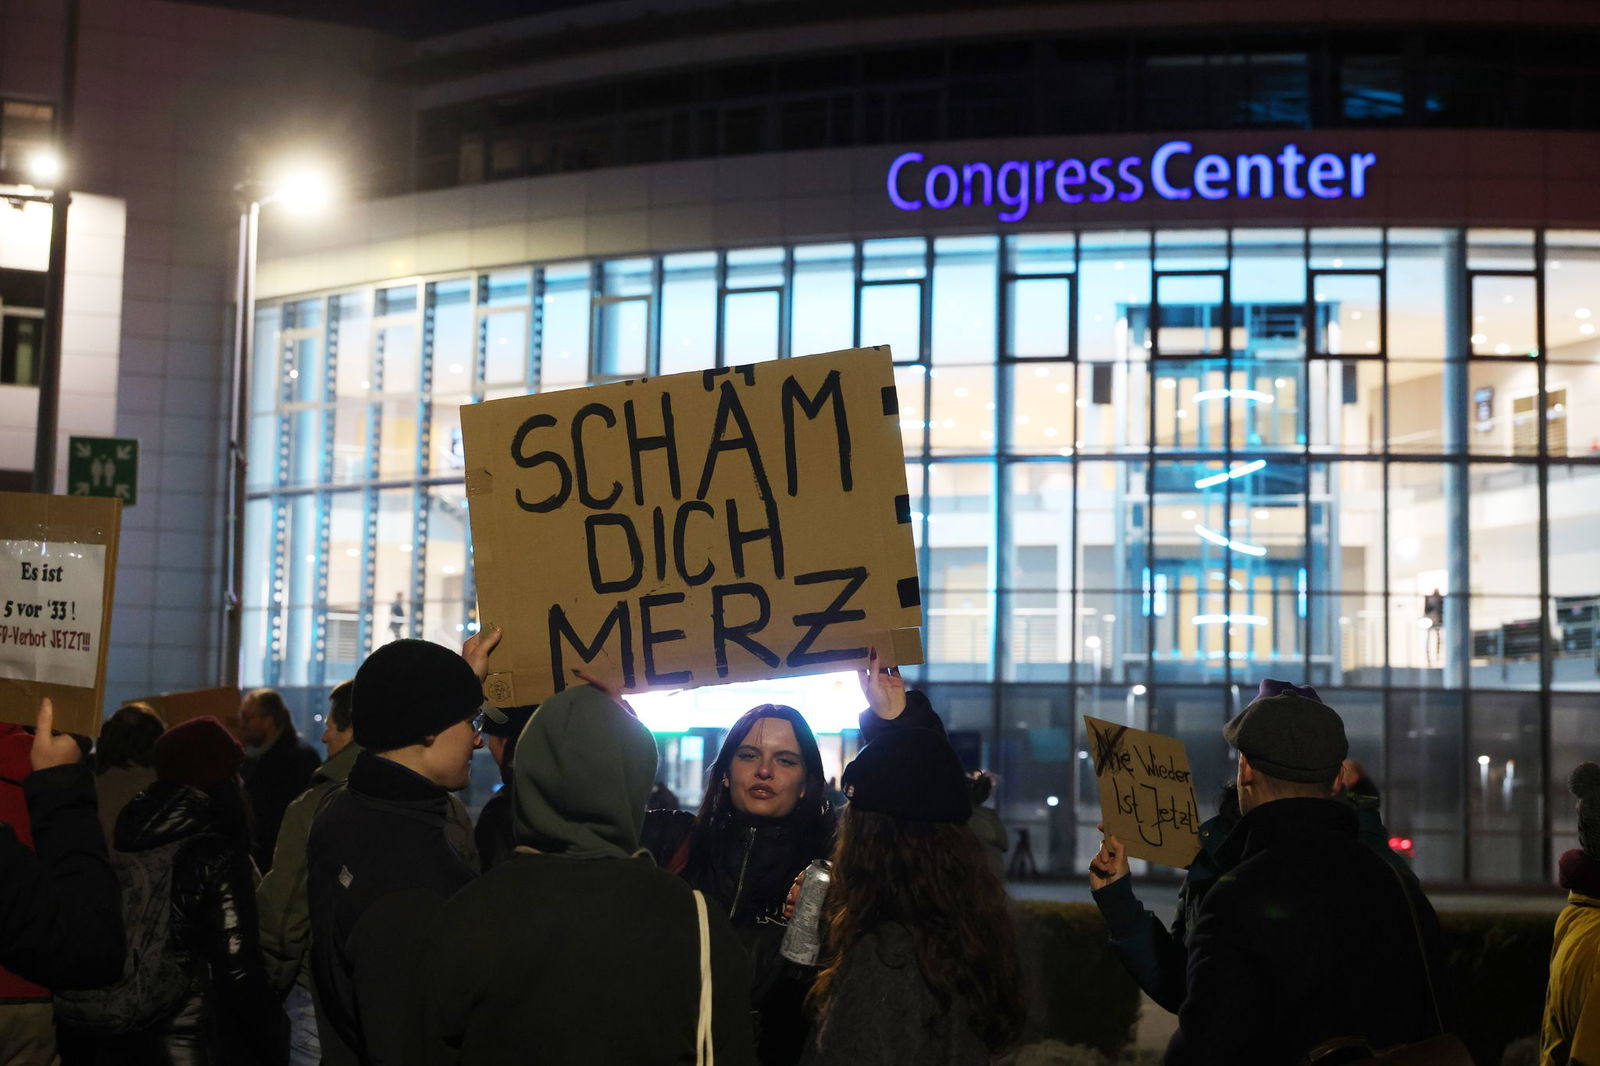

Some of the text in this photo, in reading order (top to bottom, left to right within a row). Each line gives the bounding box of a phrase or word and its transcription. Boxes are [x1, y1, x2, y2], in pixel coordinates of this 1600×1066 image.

[511, 364, 852, 513] SCHÄM
[585, 498, 785, 594] DICH
[21, 562, 63, 583] Es ist
[4, 600, 13, 618] 5
[17, 602, 42, 618] vor
[548, 566, 869, 693] MERZ
[1134, 745, 1191, 783] Wieder
[1112, 777, 1144, 824] Ist
